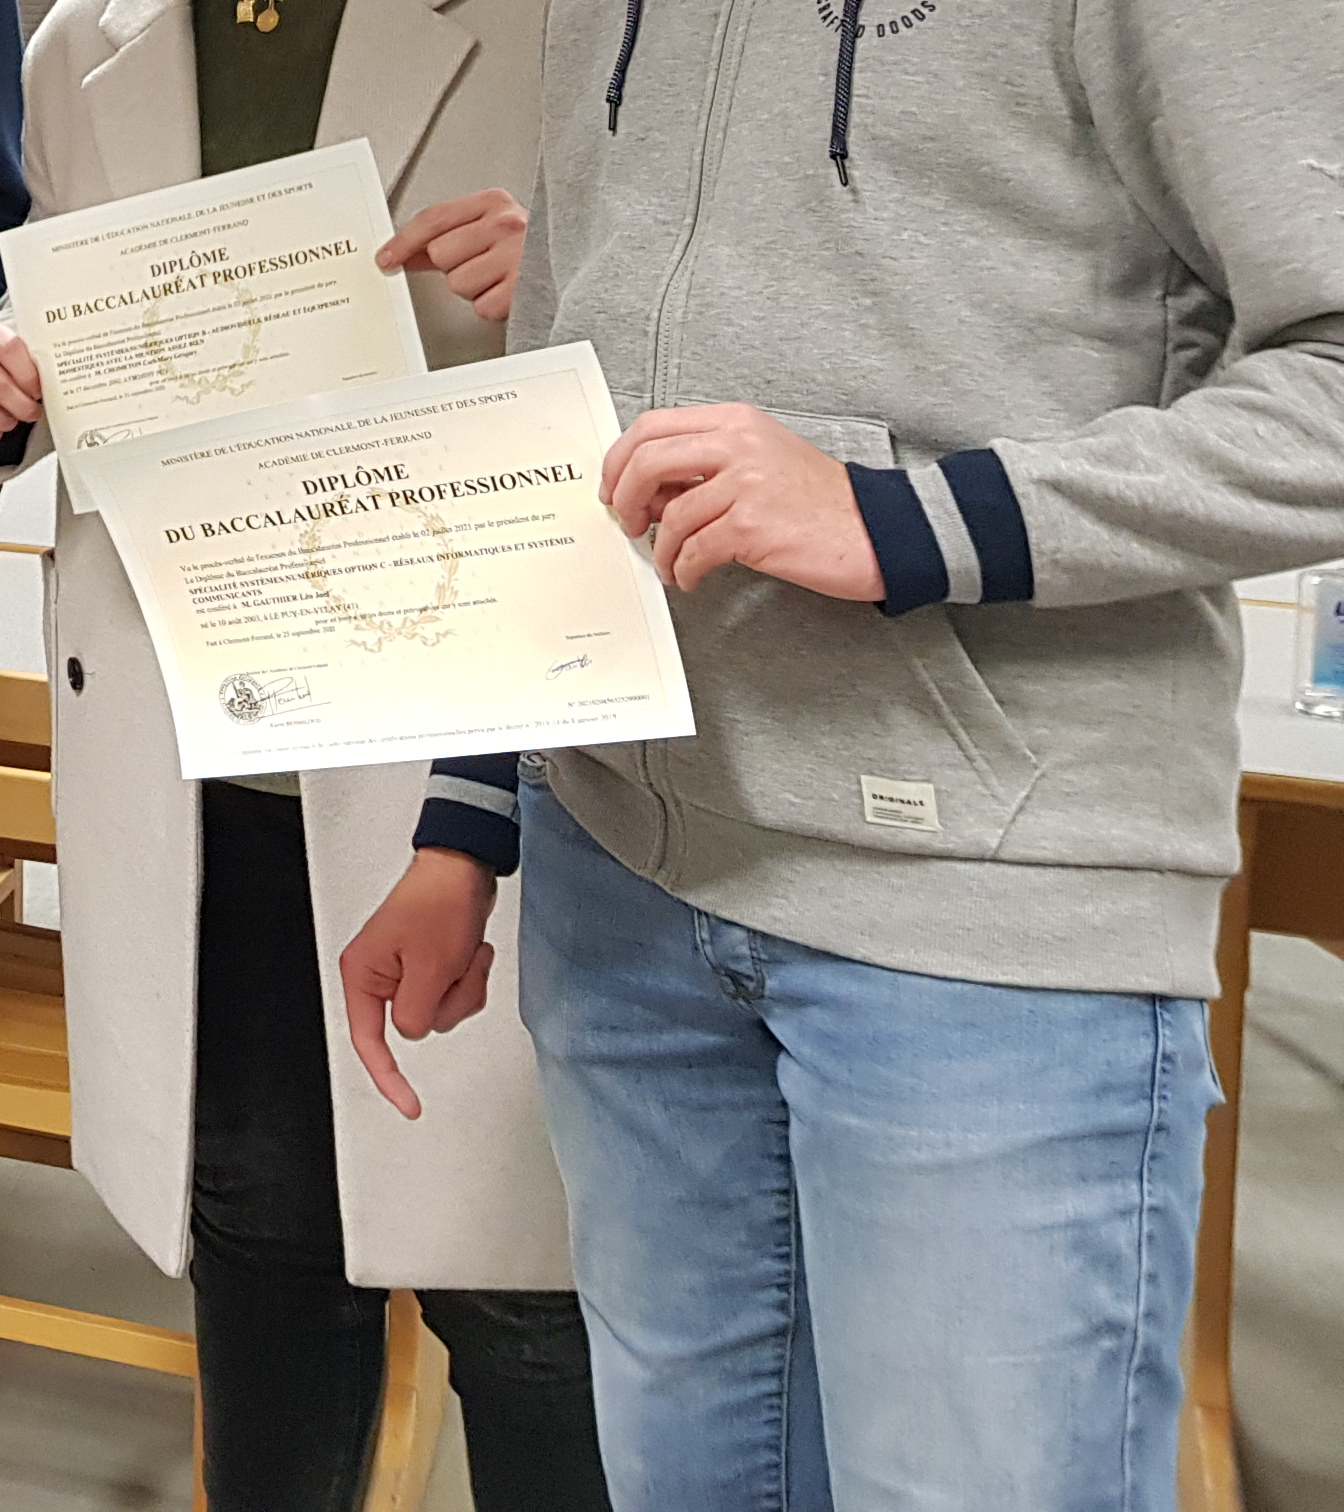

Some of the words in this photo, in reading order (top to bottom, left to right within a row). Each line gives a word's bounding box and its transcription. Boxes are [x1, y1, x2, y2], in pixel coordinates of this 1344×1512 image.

[195, 209, 204, 217] DE
[206, 206, 217, 214] LA
[45, 307, 66, 323] DU
[71, 273, 206, 317] BACCALAURÉAT
[212, 239, 357, 284] PROFESSIONNEL
[150, 247, 229, 277] DIPLÔME
[160, 450, 211, 466] MINISTÈRE
[213, 447, 228, 455] DE
[356, 418, 371, 427] DE
[373, 415, 388, 424] LA
[389, 405, 438, 421] JEUNESSE
[440, 402, 452, 411] ET
[455, 398, 476, 408] DES
[477, 390, 517, 403] SPORTS
[258, 453, 307, 469] ACADÉMIE
[310, 451, 324, 459] DE
[325, 431, 431, 456] CLERMONT-FERRAND
[164, 525, 194, 543] DU
[200, 493, 380, 537] BACCALAURÉAT
[387, 463, 582, 507] PROFESSIONNEL
[301, 463, 409, 495] DIPLÔME
[188, 581, 236, 594] SPÉCIALITÉ
[239, 576, 284, 587] SYSTÈMES
[344, 563, 377, 573] OPTION
[392, 555, 434, 566] RÉSEAUX
[436, 545, 512, 561] INFORMATIQUES
[527, 536, 574, 548] SYSTÈMES
